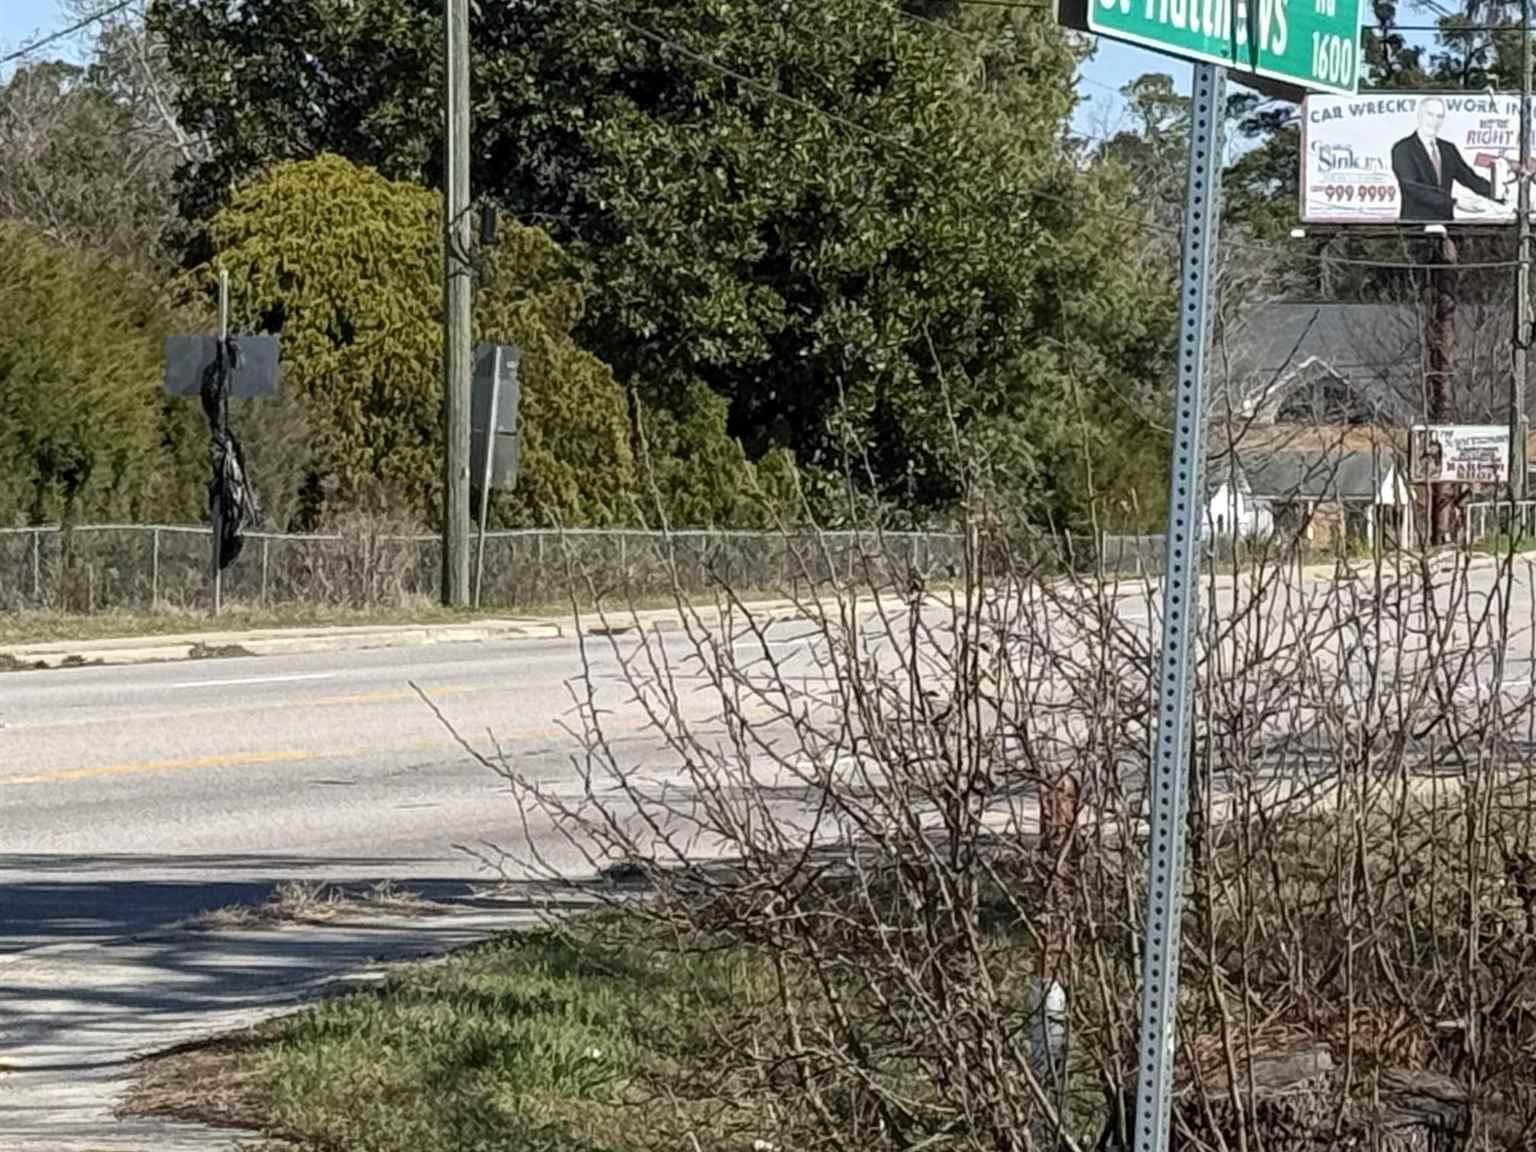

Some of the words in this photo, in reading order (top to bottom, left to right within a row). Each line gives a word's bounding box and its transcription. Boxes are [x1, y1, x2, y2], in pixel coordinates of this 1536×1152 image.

[1311, 31, 1352, 85] 1600
[1310, 105, 1343, 123] CAR
[1348, 99, 1417, 117] WRECK?
[1446, 98, 1499, 114] WORK
